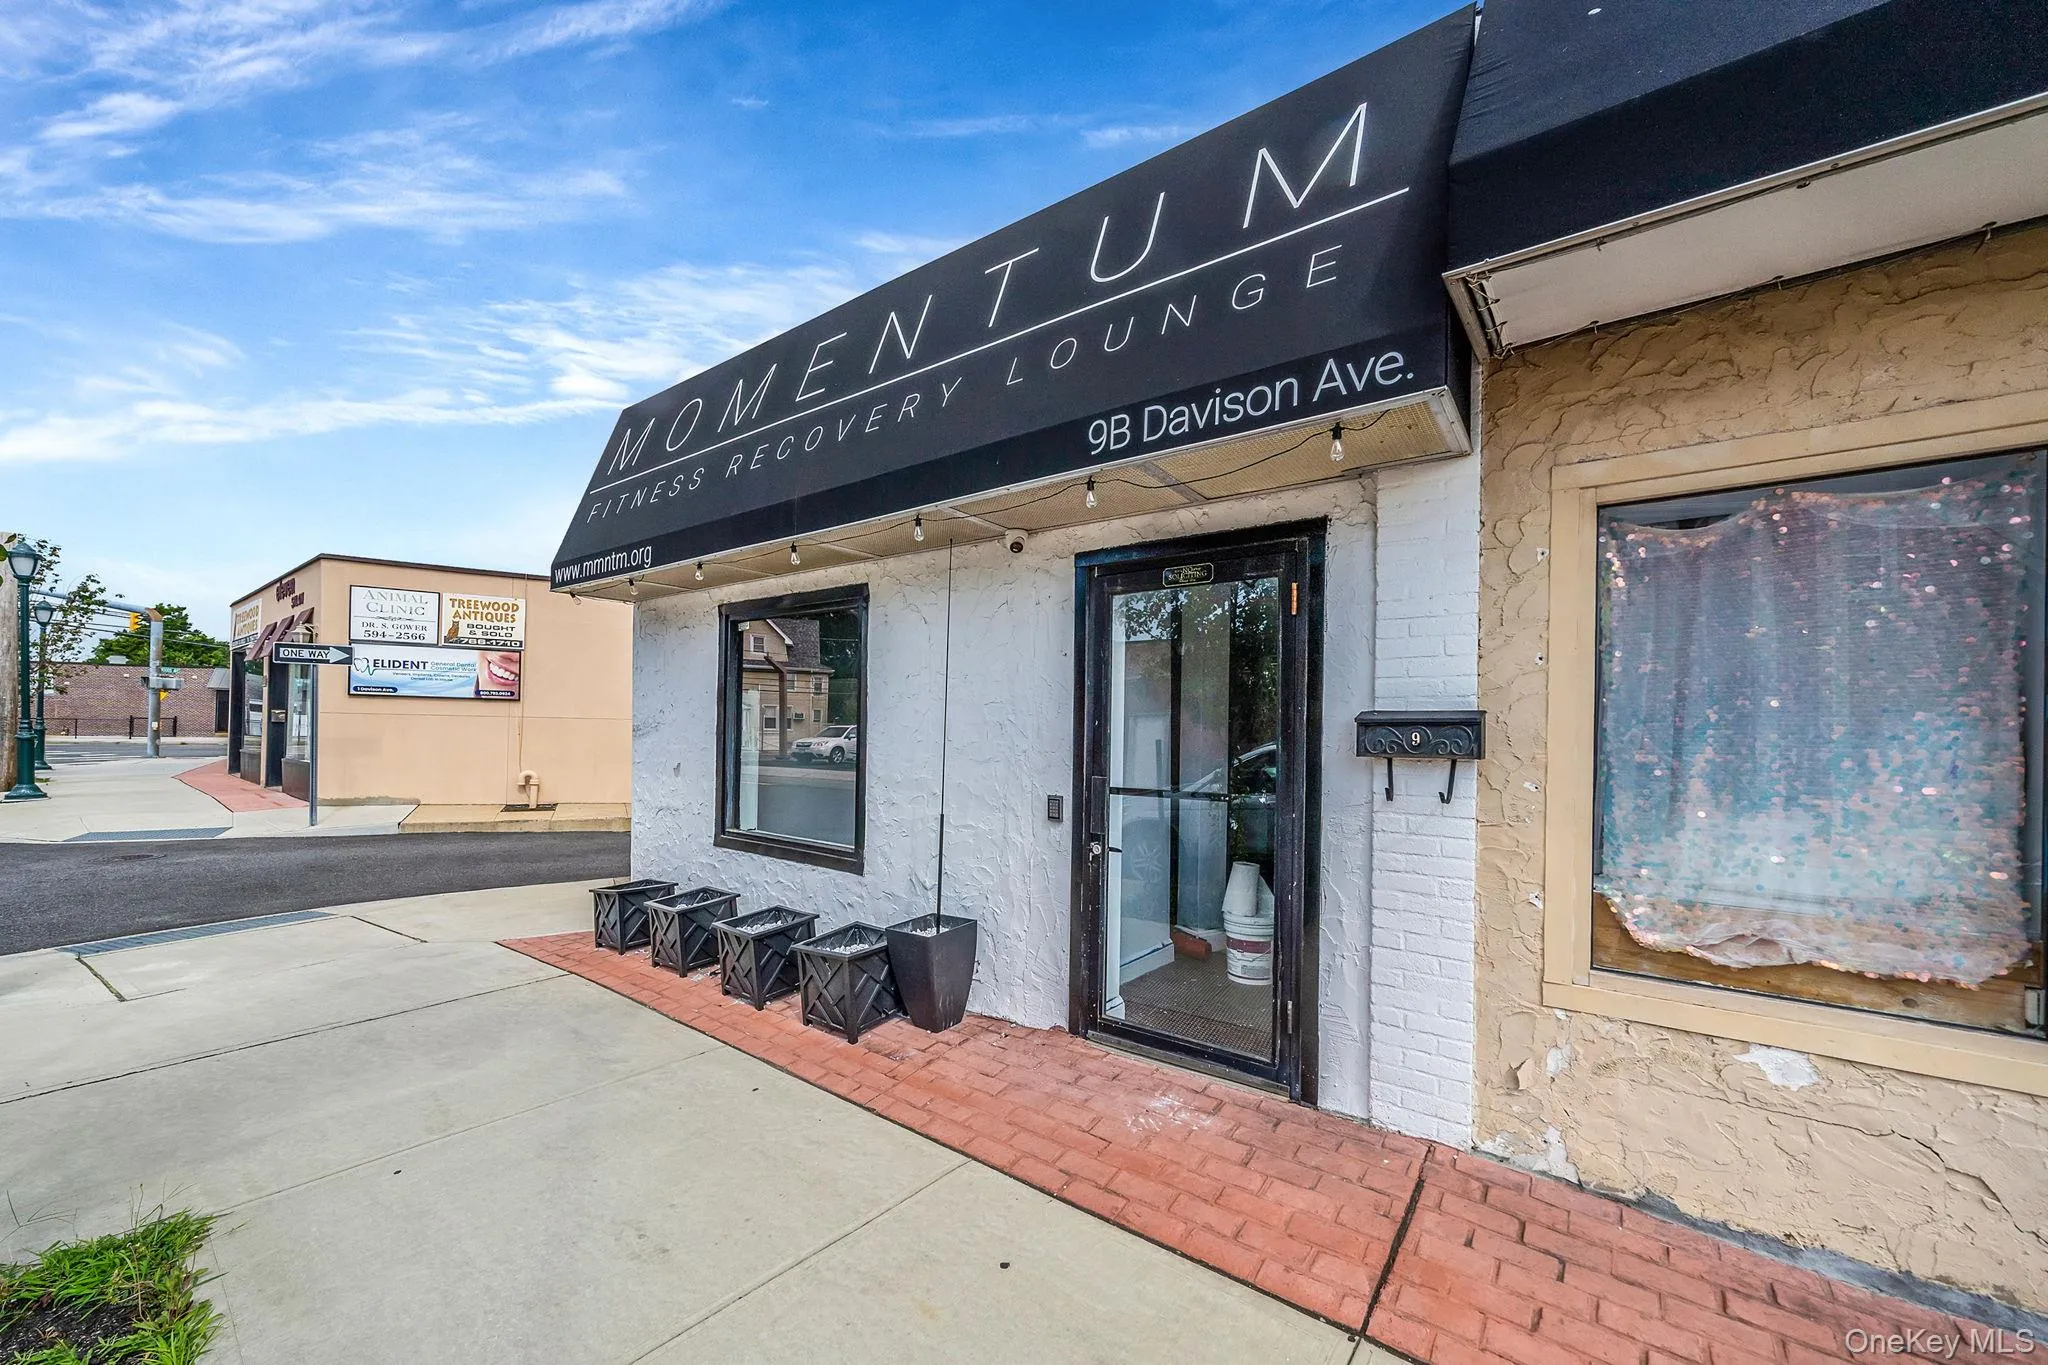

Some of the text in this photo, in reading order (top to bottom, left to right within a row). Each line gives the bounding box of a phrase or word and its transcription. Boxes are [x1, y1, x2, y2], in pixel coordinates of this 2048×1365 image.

[607, 102, 1367, 476] MOMENTUM
[586, 245, 1342, 523] FITNESS RECOVERY LOUNGE
[1088, 350, 1414, 455] 9B Davison Ave.
[555, 545, 652, 583] www.mmntm.org
[363, 590, 429, 604] ANIMAL
[366, 602, 425, 616] CLINIC
[449, 598, 520, 613] TREEWOOD
[452, 609, 517, 624] ANTIQUES
[361, 621, 428, 632] DR. S. GOWER
[467, 623, 516, 632] BOUGHT
[363, 630, 426, 641] 594-2566
[282, 649, 330, 659] ONE WAY
[373, 659, 429, 670] ELIDENT
[1411, 732, 1420, 746] 9
